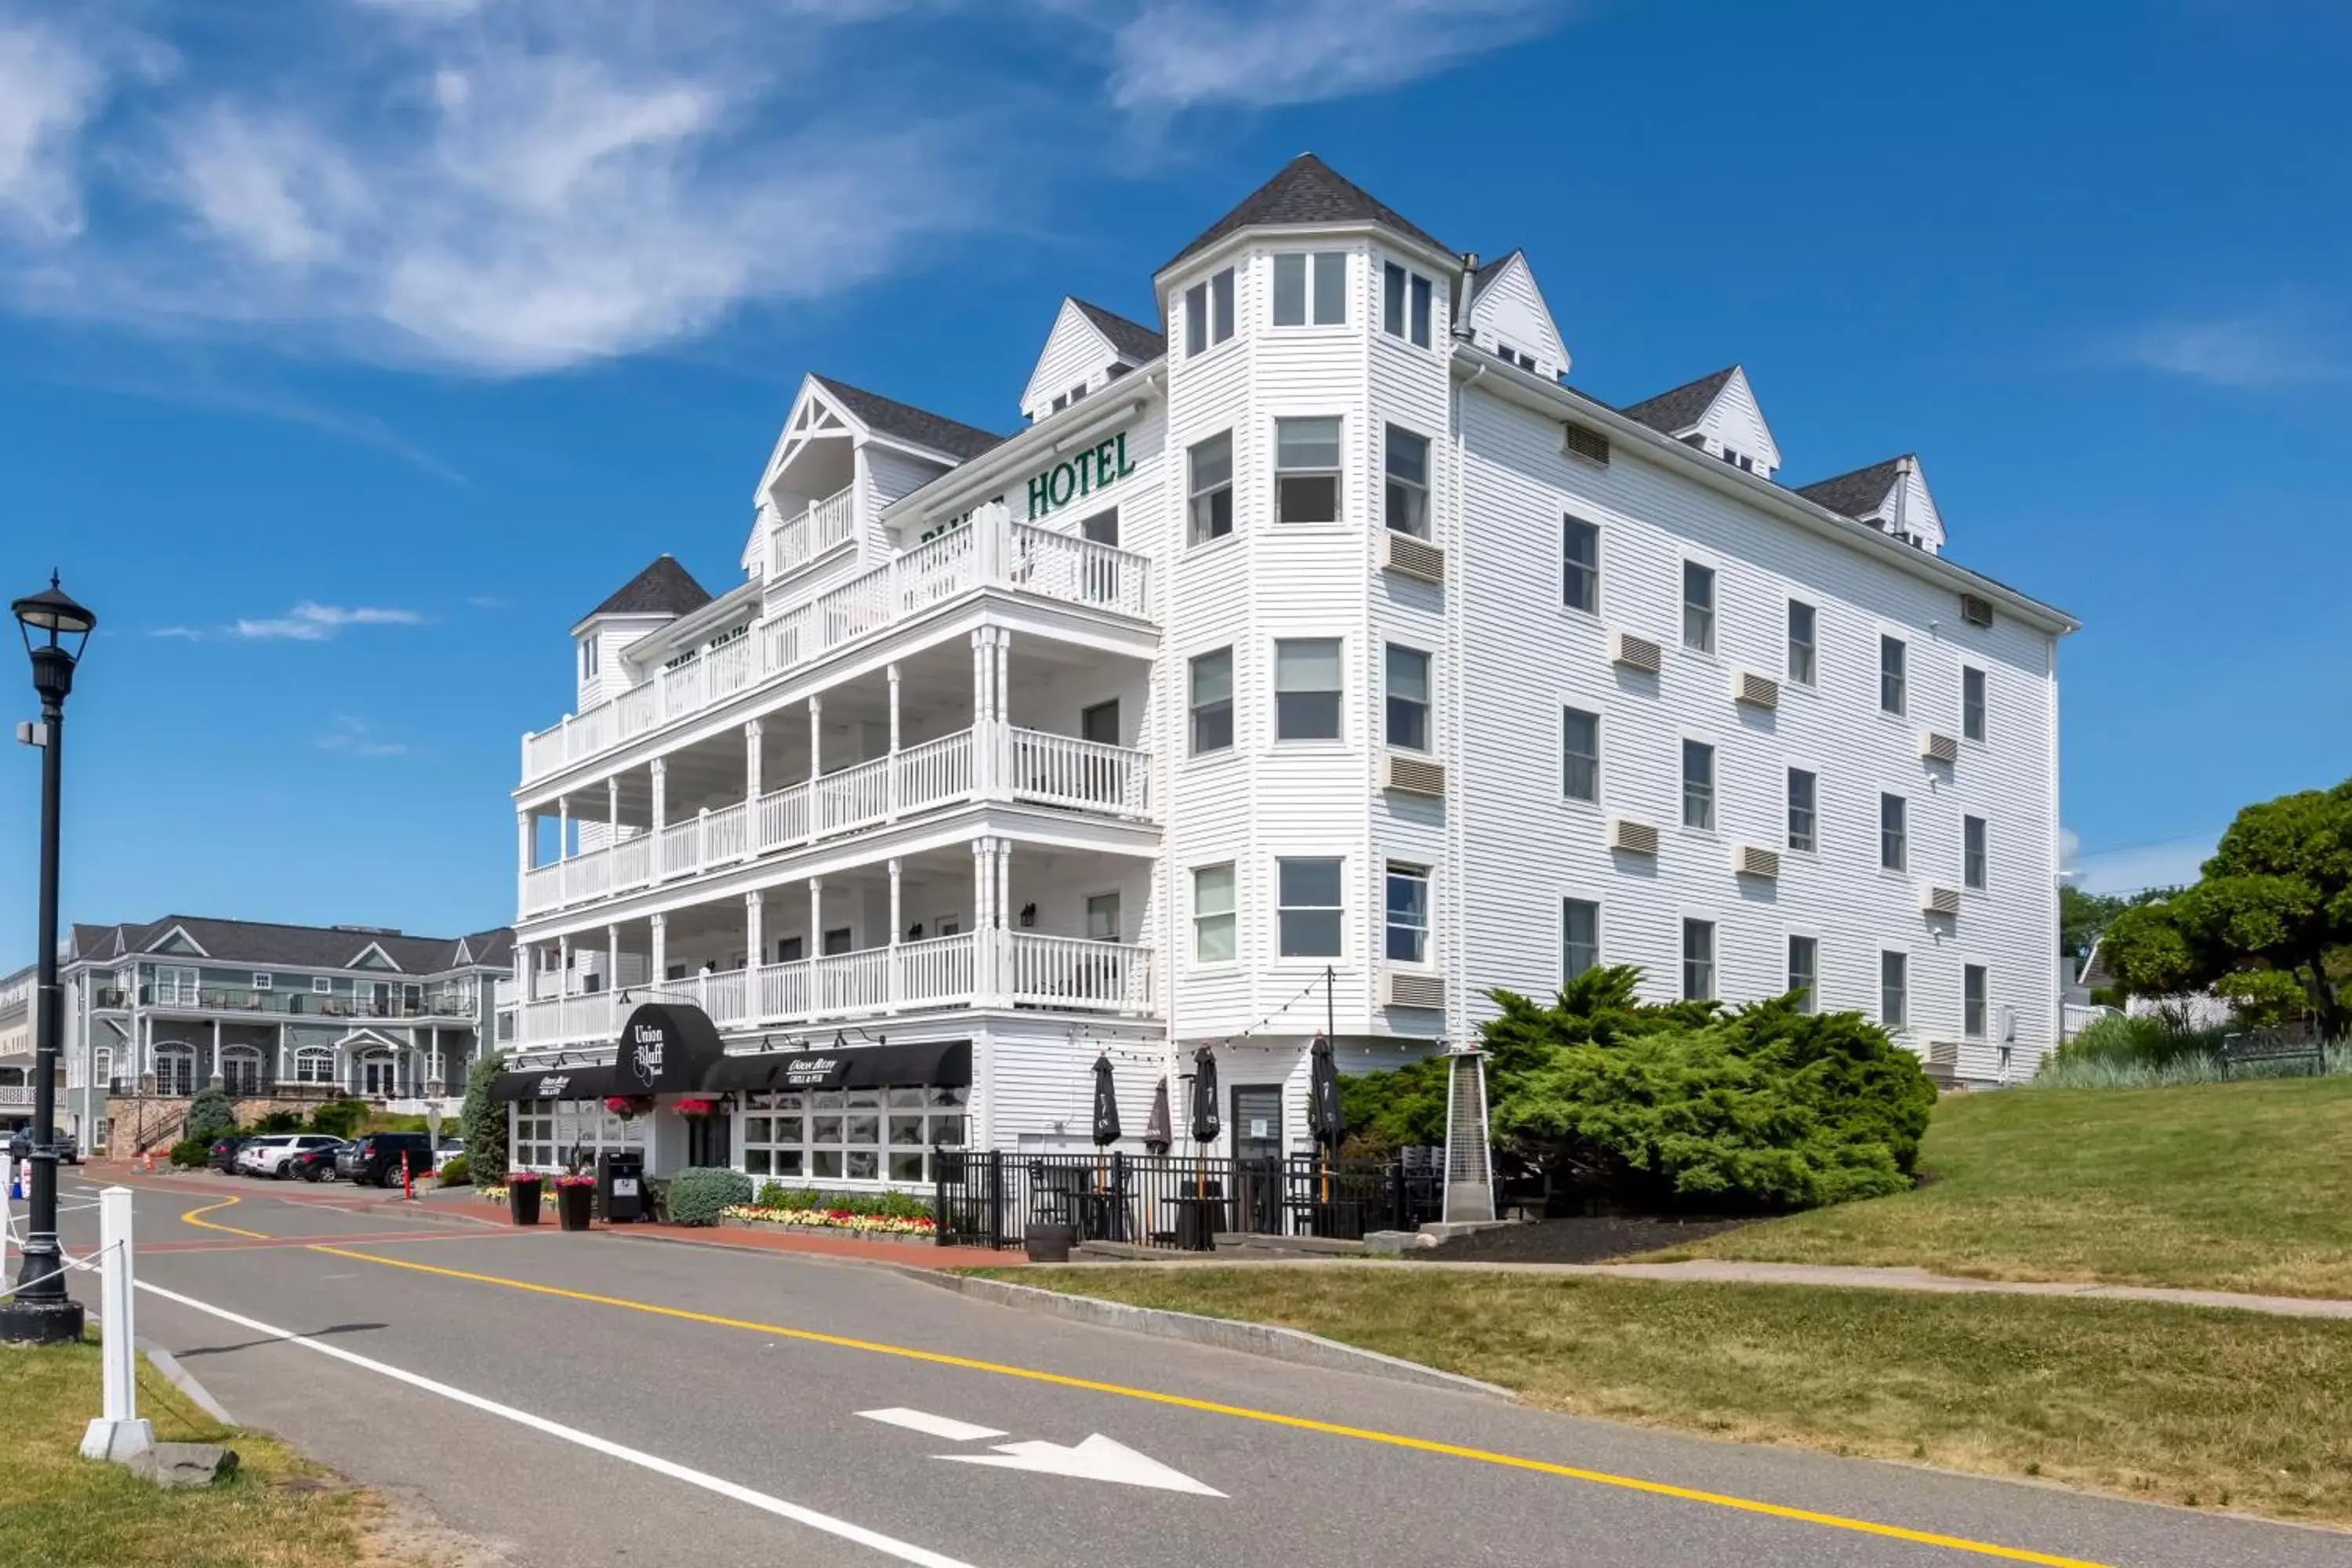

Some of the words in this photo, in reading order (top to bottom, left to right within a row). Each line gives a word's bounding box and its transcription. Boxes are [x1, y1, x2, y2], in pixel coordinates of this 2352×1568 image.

[1028, 431, 1136, 521] HOTEL
[634, 1025, 662, 1044] Union
[633, 1043, 664, 1064] Bluff
